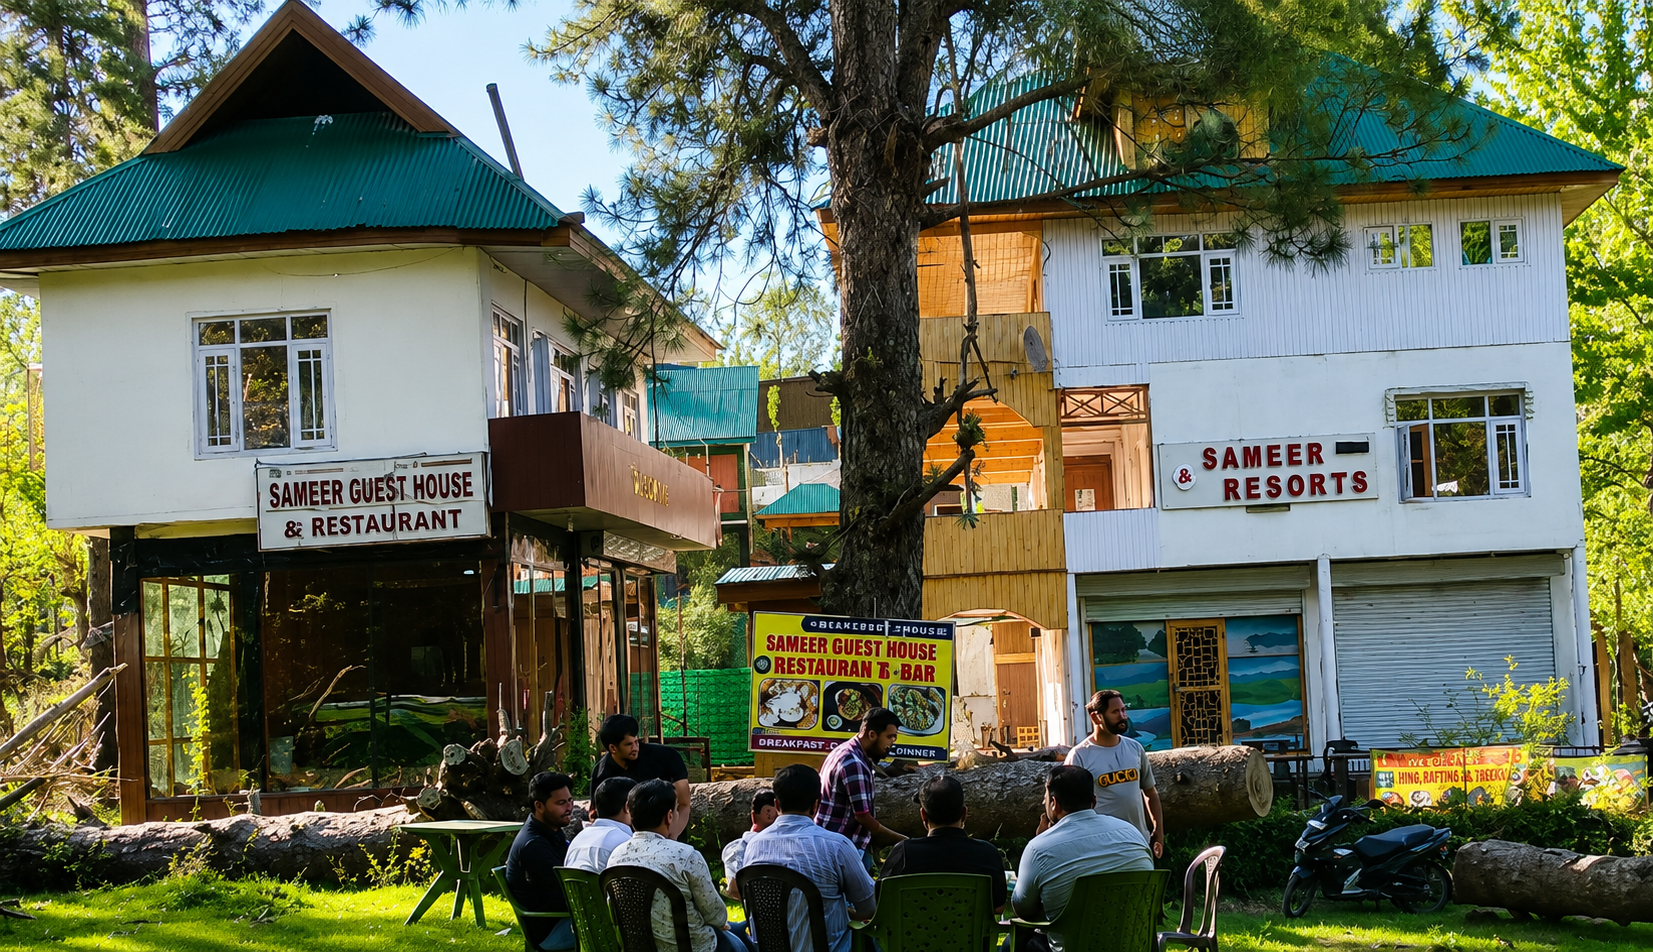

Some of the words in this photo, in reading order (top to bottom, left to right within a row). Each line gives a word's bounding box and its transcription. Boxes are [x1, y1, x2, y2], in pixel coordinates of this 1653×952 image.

[1202, 443, 1325, 470] SAMEER
[269, 479, 344, 509] SAMEER
[350, 475, 407, 504] GUEST
[413, 471, 474, 500] HOUSE
[1178, 468, 1192, 483] &
[1224, 470, 1369, 501] RESORTS
[312, 508, 462, 537] RESTAURANT
[766, 635, 829, 654] SAMEER
[832, 638, 883, 657] GUEST
[887, 643, 937, 661] HOUSE
[900, 663, 936, 683] BAR
[1423, 769, 1460, 784] RAFTING
